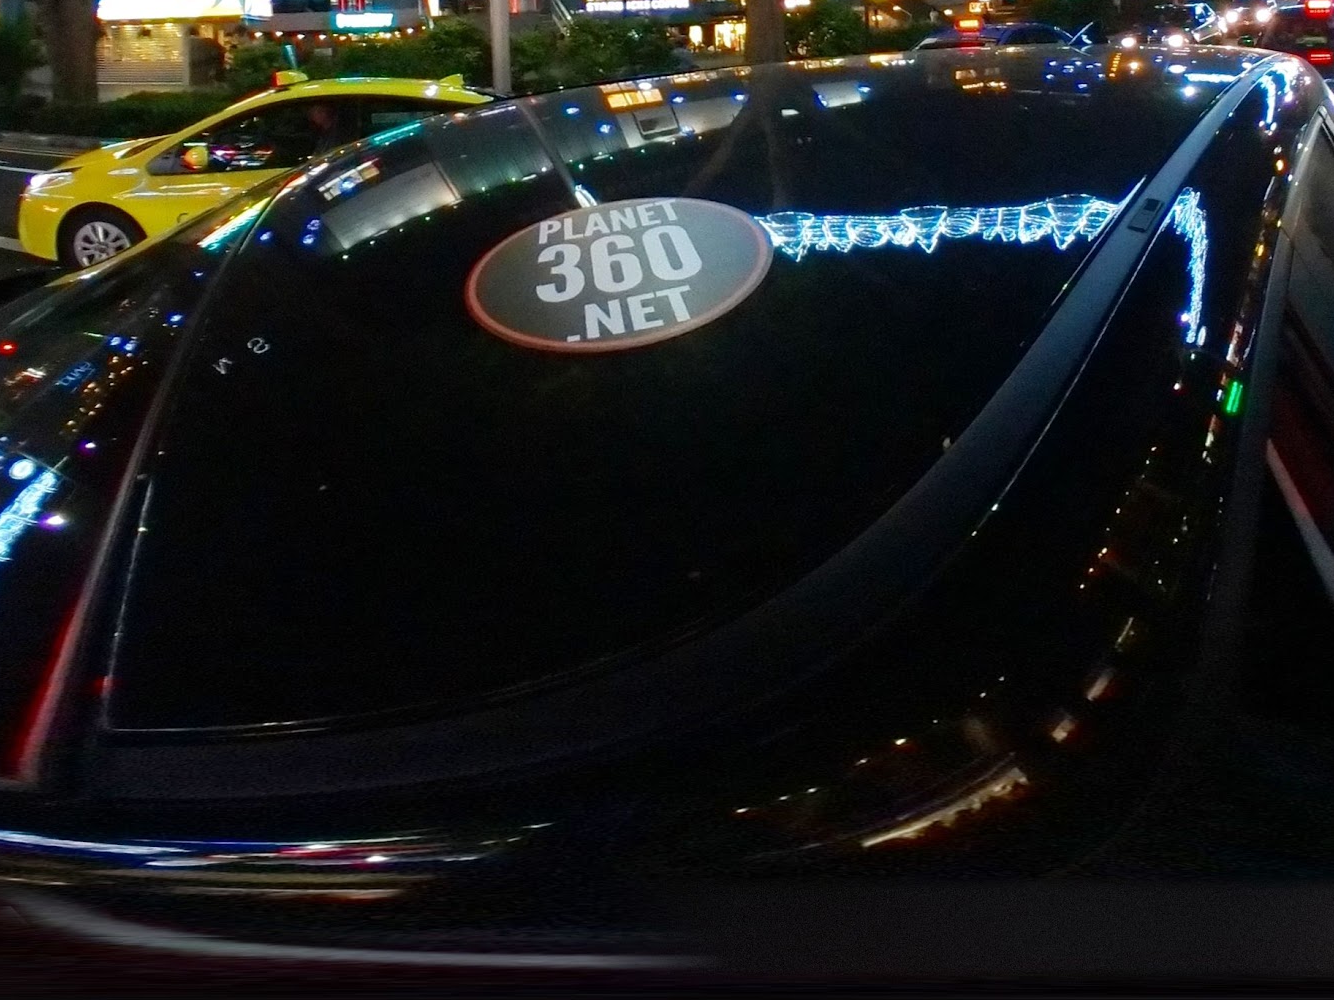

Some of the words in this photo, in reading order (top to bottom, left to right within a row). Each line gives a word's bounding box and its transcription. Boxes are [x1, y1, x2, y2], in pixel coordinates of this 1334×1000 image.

[538, 199, 679, 245] PLANET
[535, 225, 703, 303] 360
[567, 285, 692, 343] .NET
